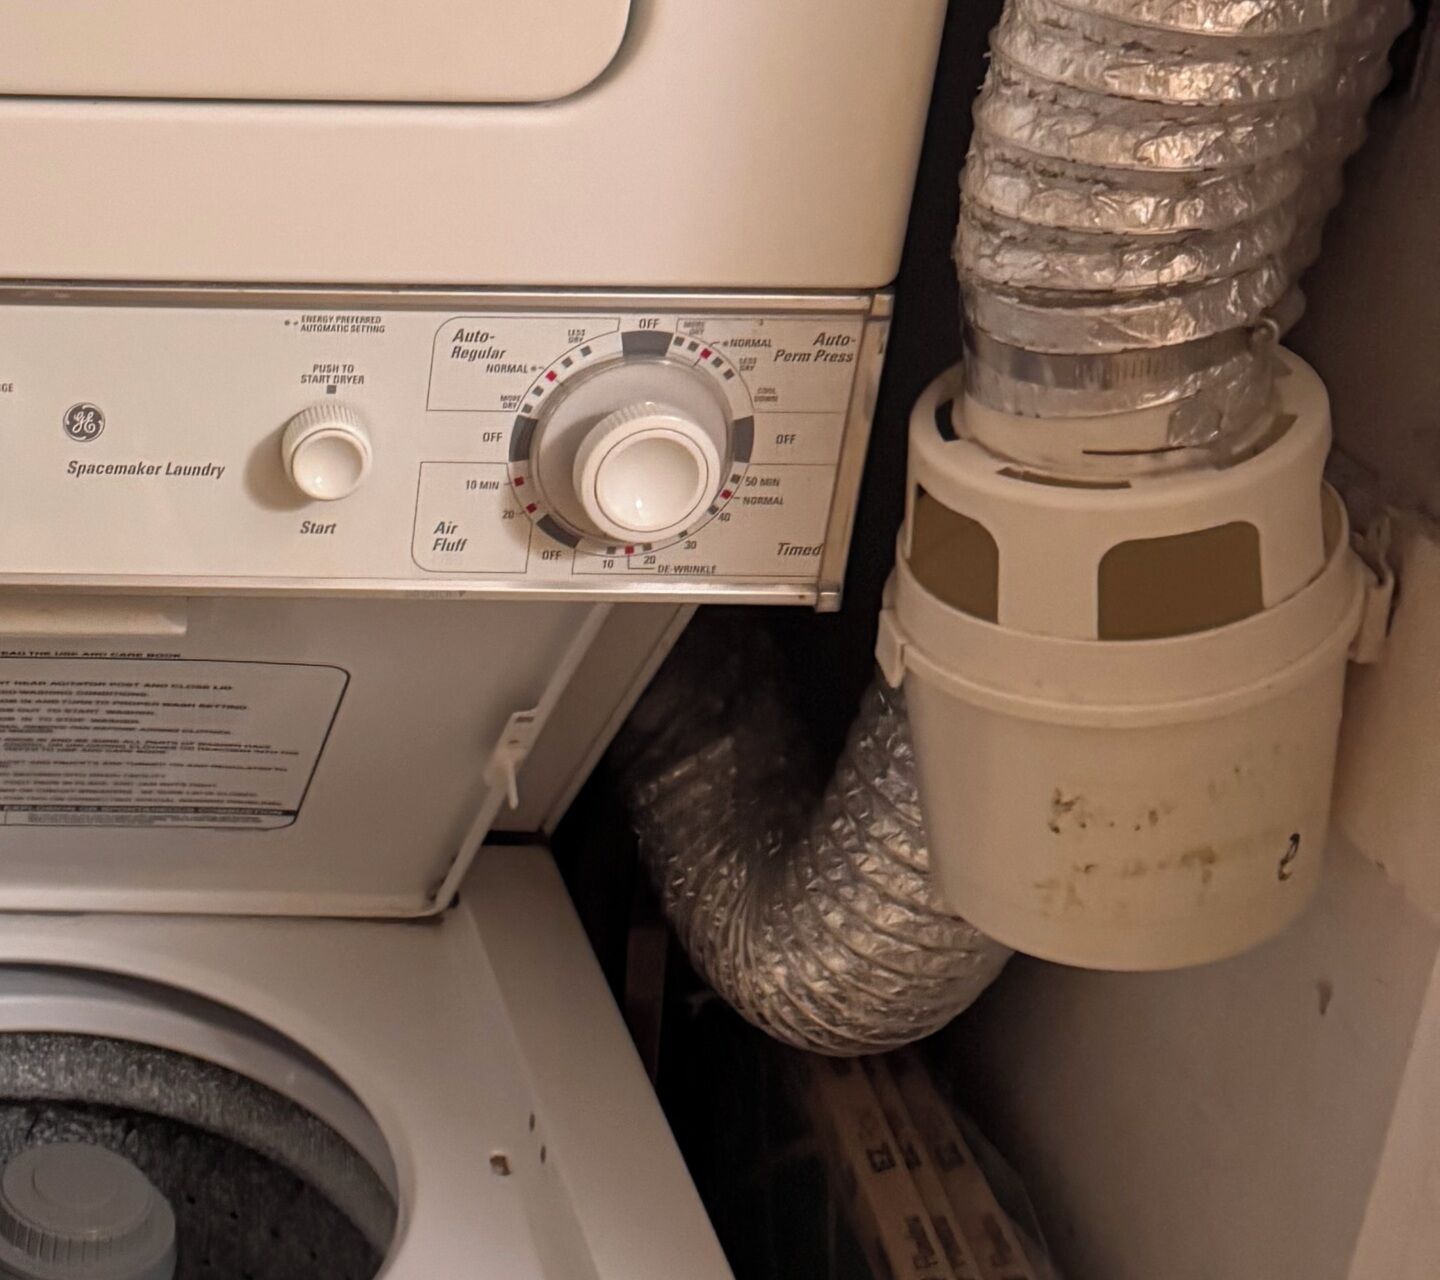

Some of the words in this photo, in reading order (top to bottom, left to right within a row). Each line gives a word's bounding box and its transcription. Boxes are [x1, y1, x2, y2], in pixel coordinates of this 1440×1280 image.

[301, 315, 334, 324] ENERGY
[335, 316, 382, 324] PREFERRED
[638, 319, 659, 329] OFF
[300, 324, 350, 333] AUTOMATIC
[350, 325, 385, 334] SETTING
[451, 328, 496, 343] Auto-
[812, 332, 857, 347] Auto-
[729, 338, 773, 348] NORMAL
[450, 346, 508, 362] Regular
[773, 349, 812, 363] Perm
[814, 350, 854, 364] Press
[312, 364, 339, 374] PUSH
[341, 364, 355, 374] TO
[486, 363, 528, 374] NORMAL
[300, 375, 332, 385] START
[333, 375, 365, 385] DRYER
[482, 432, 503, 443] OFF
[775, 434, 797, 445] OFF
[67, 461, 161, 476] Spacemaker
[165, 462, 226, 479] Laundry
[465, 480, 477, 491] 10
[479, 481, 500, 491] MIN
[745, 477, 758, 487] 50
[759, 477, 780, 487] MIN
[742, 495, 785, 506] NORMAL
[502, 510, 515, 520] 20
[717, 512, 731, 522] 40
[299, 521, 336, 535] Start
[433, 521, 459, 535] Air
[432, 538, 468, 552] Fluff
[683, 540, 697, 550] 30
[775, 542, 824, 557] Timed
[541, 551, 562, 561] OFF
[643, 555, 656, 565] 20
[602, 559, 614, 569] 10
